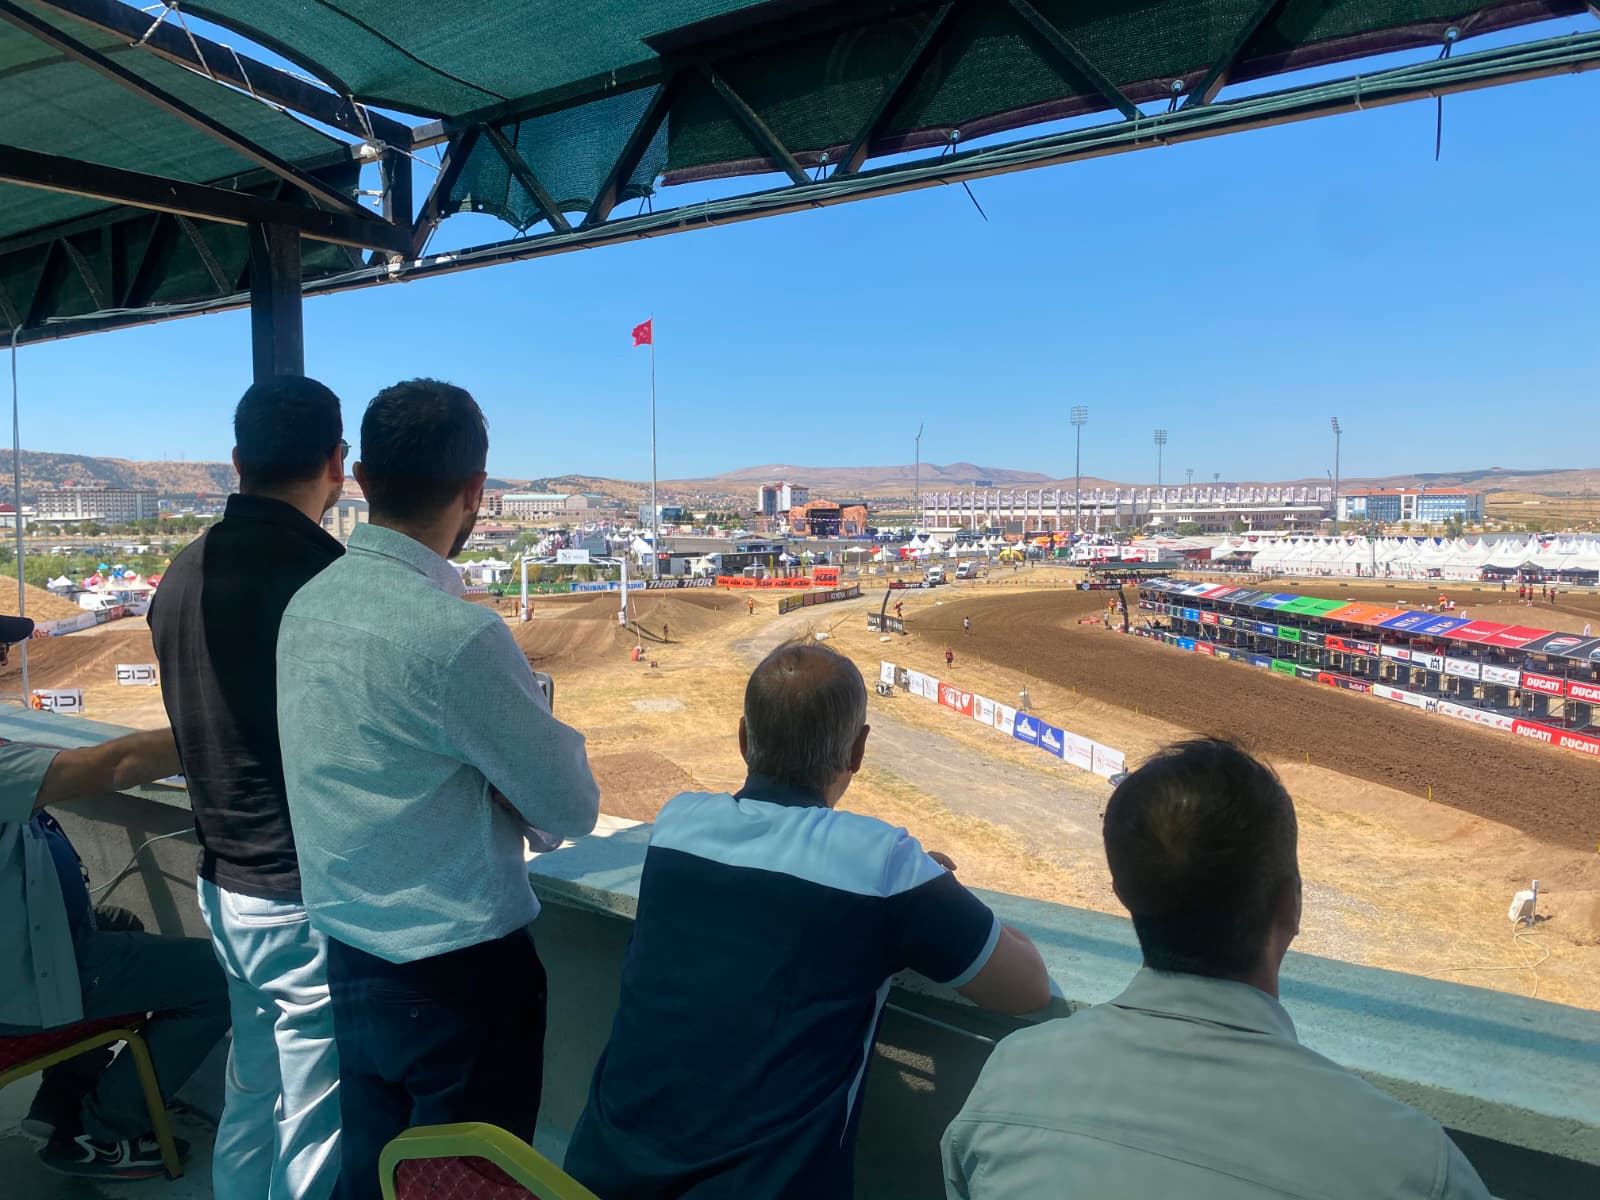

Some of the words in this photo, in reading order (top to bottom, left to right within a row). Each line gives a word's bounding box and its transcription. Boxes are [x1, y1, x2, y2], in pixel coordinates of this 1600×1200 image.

[682, 578, 713, 588] THOR
[815, 573, 838, 582] KTM
[649, 579, 680, 589] THOR
[1526, 678, 1559, 691] DUCATI
[1517, 726, 1552, 742] DUCATI
[1561, 737, 1599, 754] DUCATI
